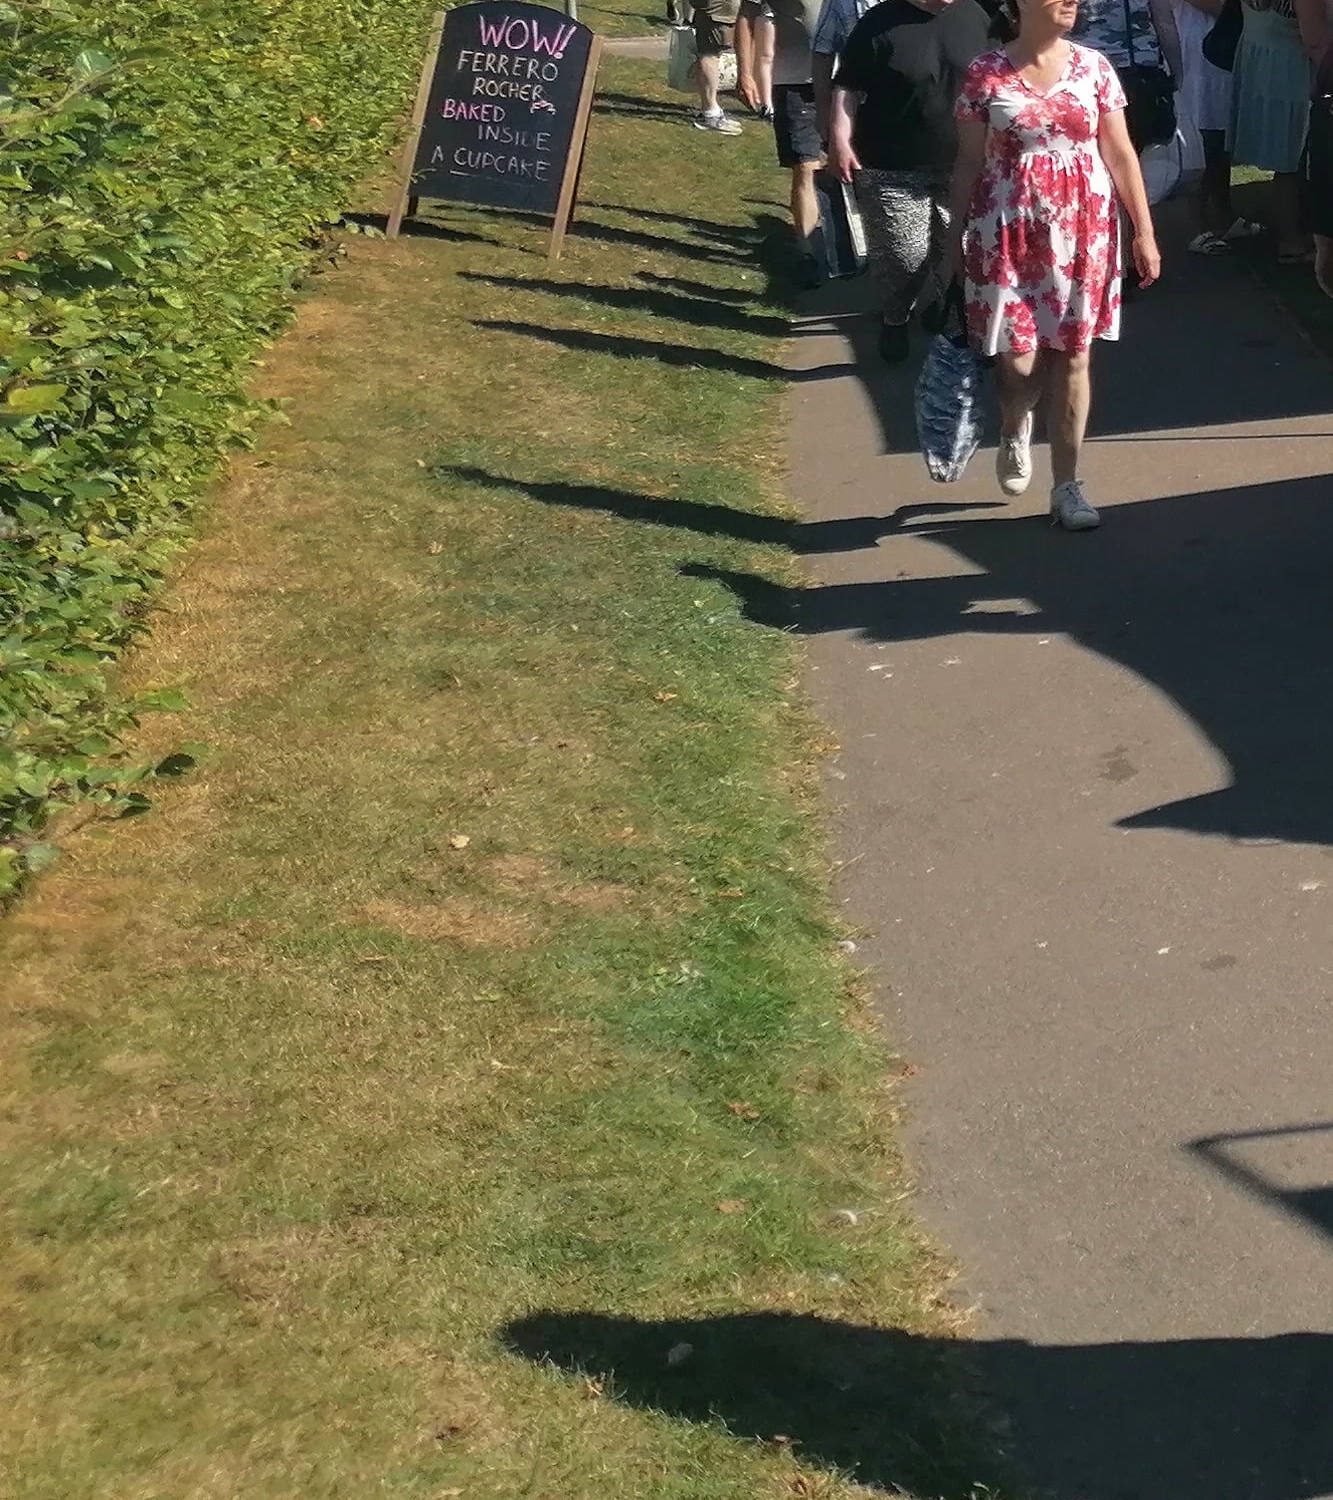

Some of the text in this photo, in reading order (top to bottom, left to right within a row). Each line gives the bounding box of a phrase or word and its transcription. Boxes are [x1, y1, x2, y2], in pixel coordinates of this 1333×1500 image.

[478, 14, 577, 60] WOW!
[458, 50, 559, 82] FERRERO
[472, 77, 545, 102] ROCHER
[442, 99, 506, 123] BAKED
[478, 125, 551, 151] INSIDE
[431, 145, 551, 183] A CUPCAKE
